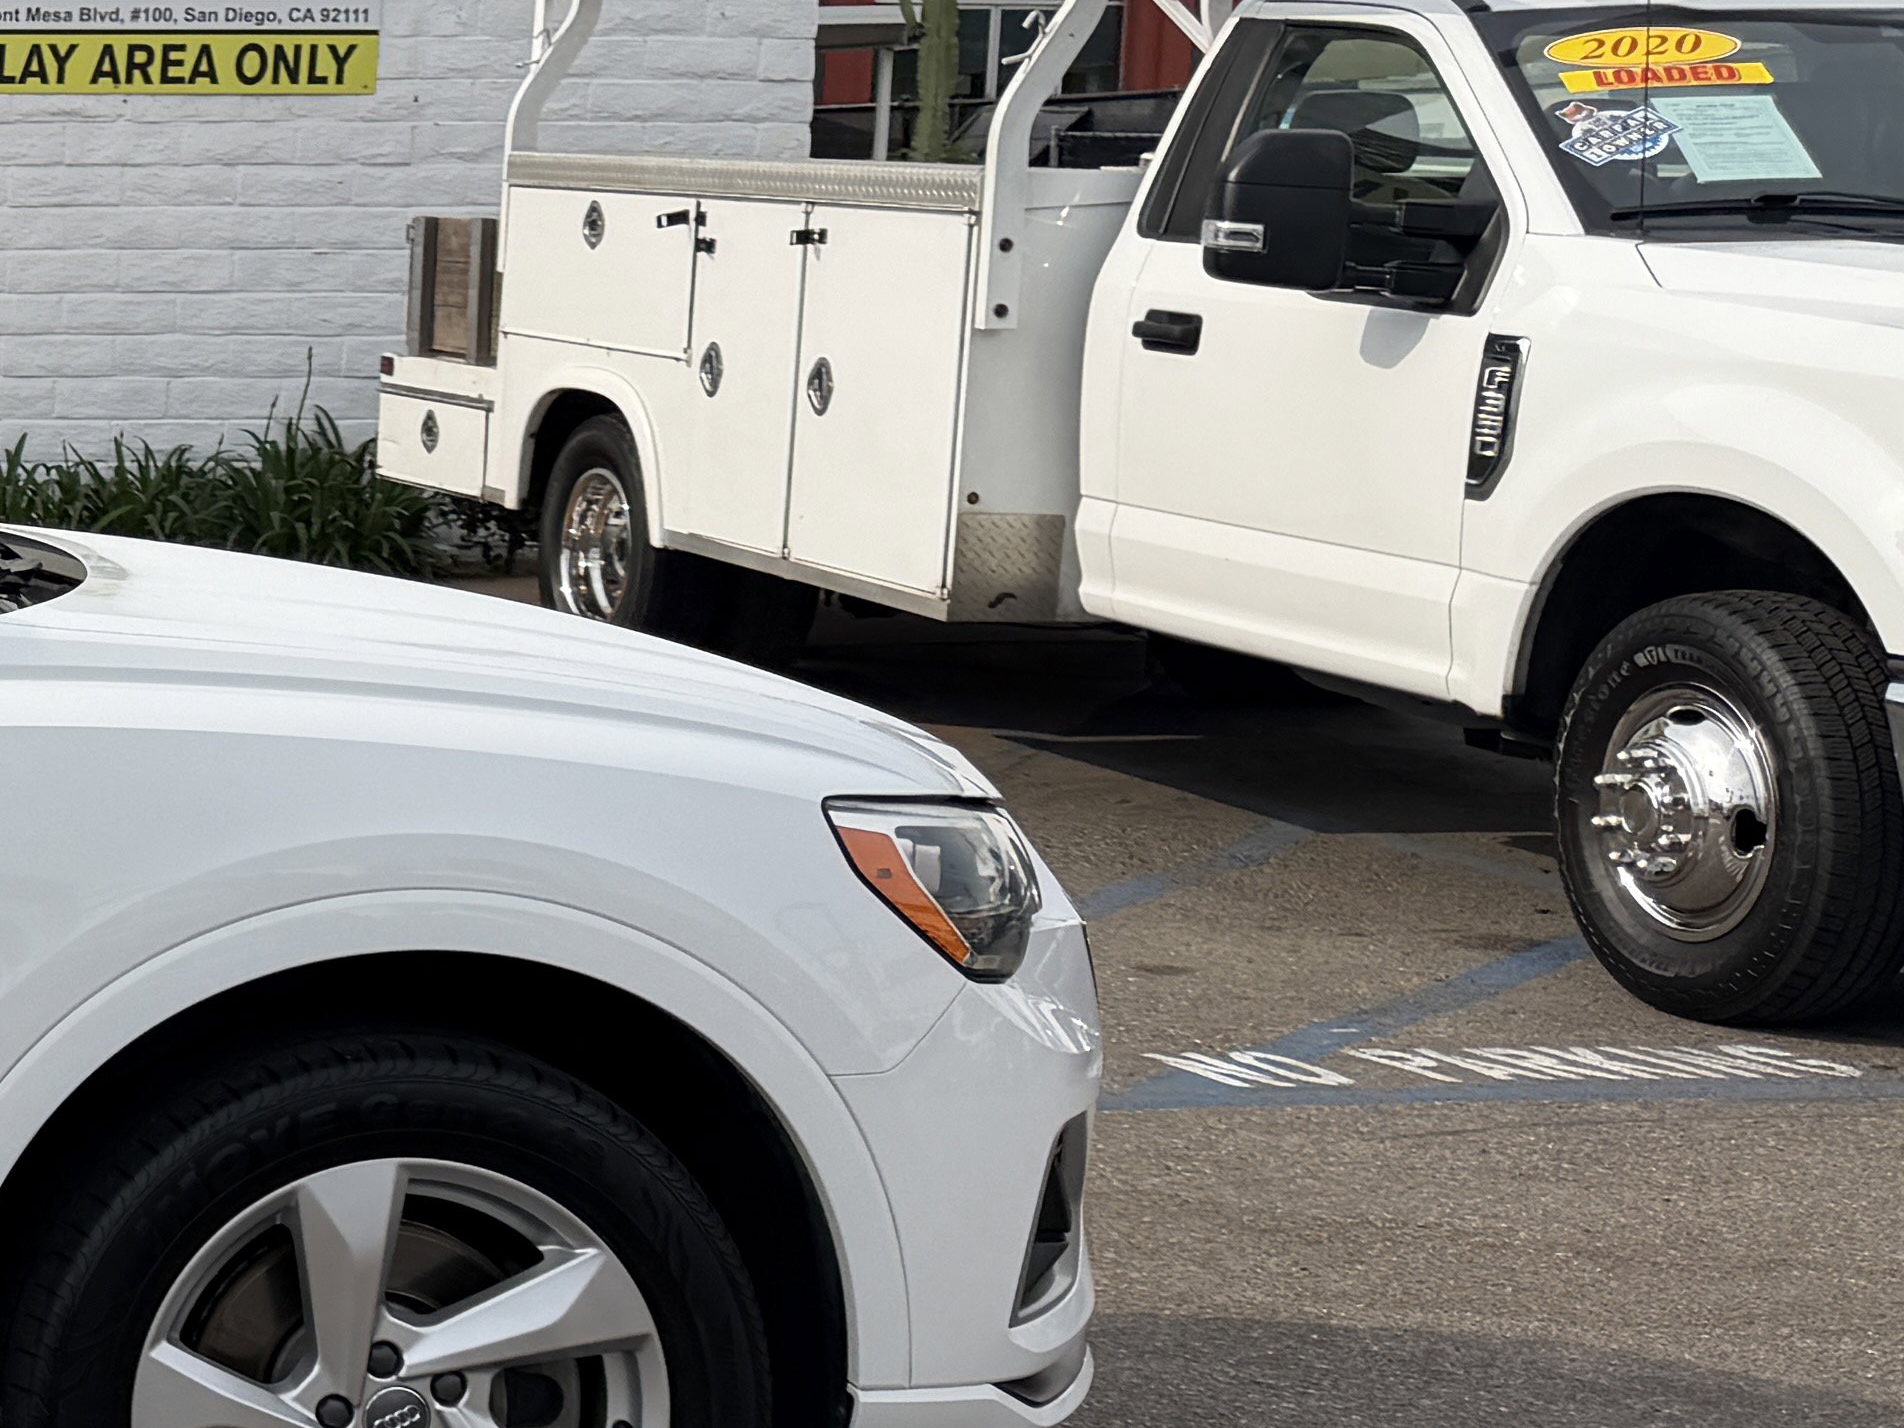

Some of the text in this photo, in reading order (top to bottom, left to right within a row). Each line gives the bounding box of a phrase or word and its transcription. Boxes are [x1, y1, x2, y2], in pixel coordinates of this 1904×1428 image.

[24, 7, 73, 23] Mesa
[79, 7, 125, 25] Blvd,
[129, 7, 178, 25] #100,
[183, 7, 219, 23] San
[224, 7, 283, 27] Diego,
[288, 7, 316, 23] CA
[319, 7, 370, 23] 92111
[1579, 33, 1702, 61] 2020
[89, 43, 220, 86] AREA
[235, 42, 359, 86] ONLY
[1592, 65, 1742, 88] LOADED
[1140, 1044, 1863, 1088] NO PARKING
